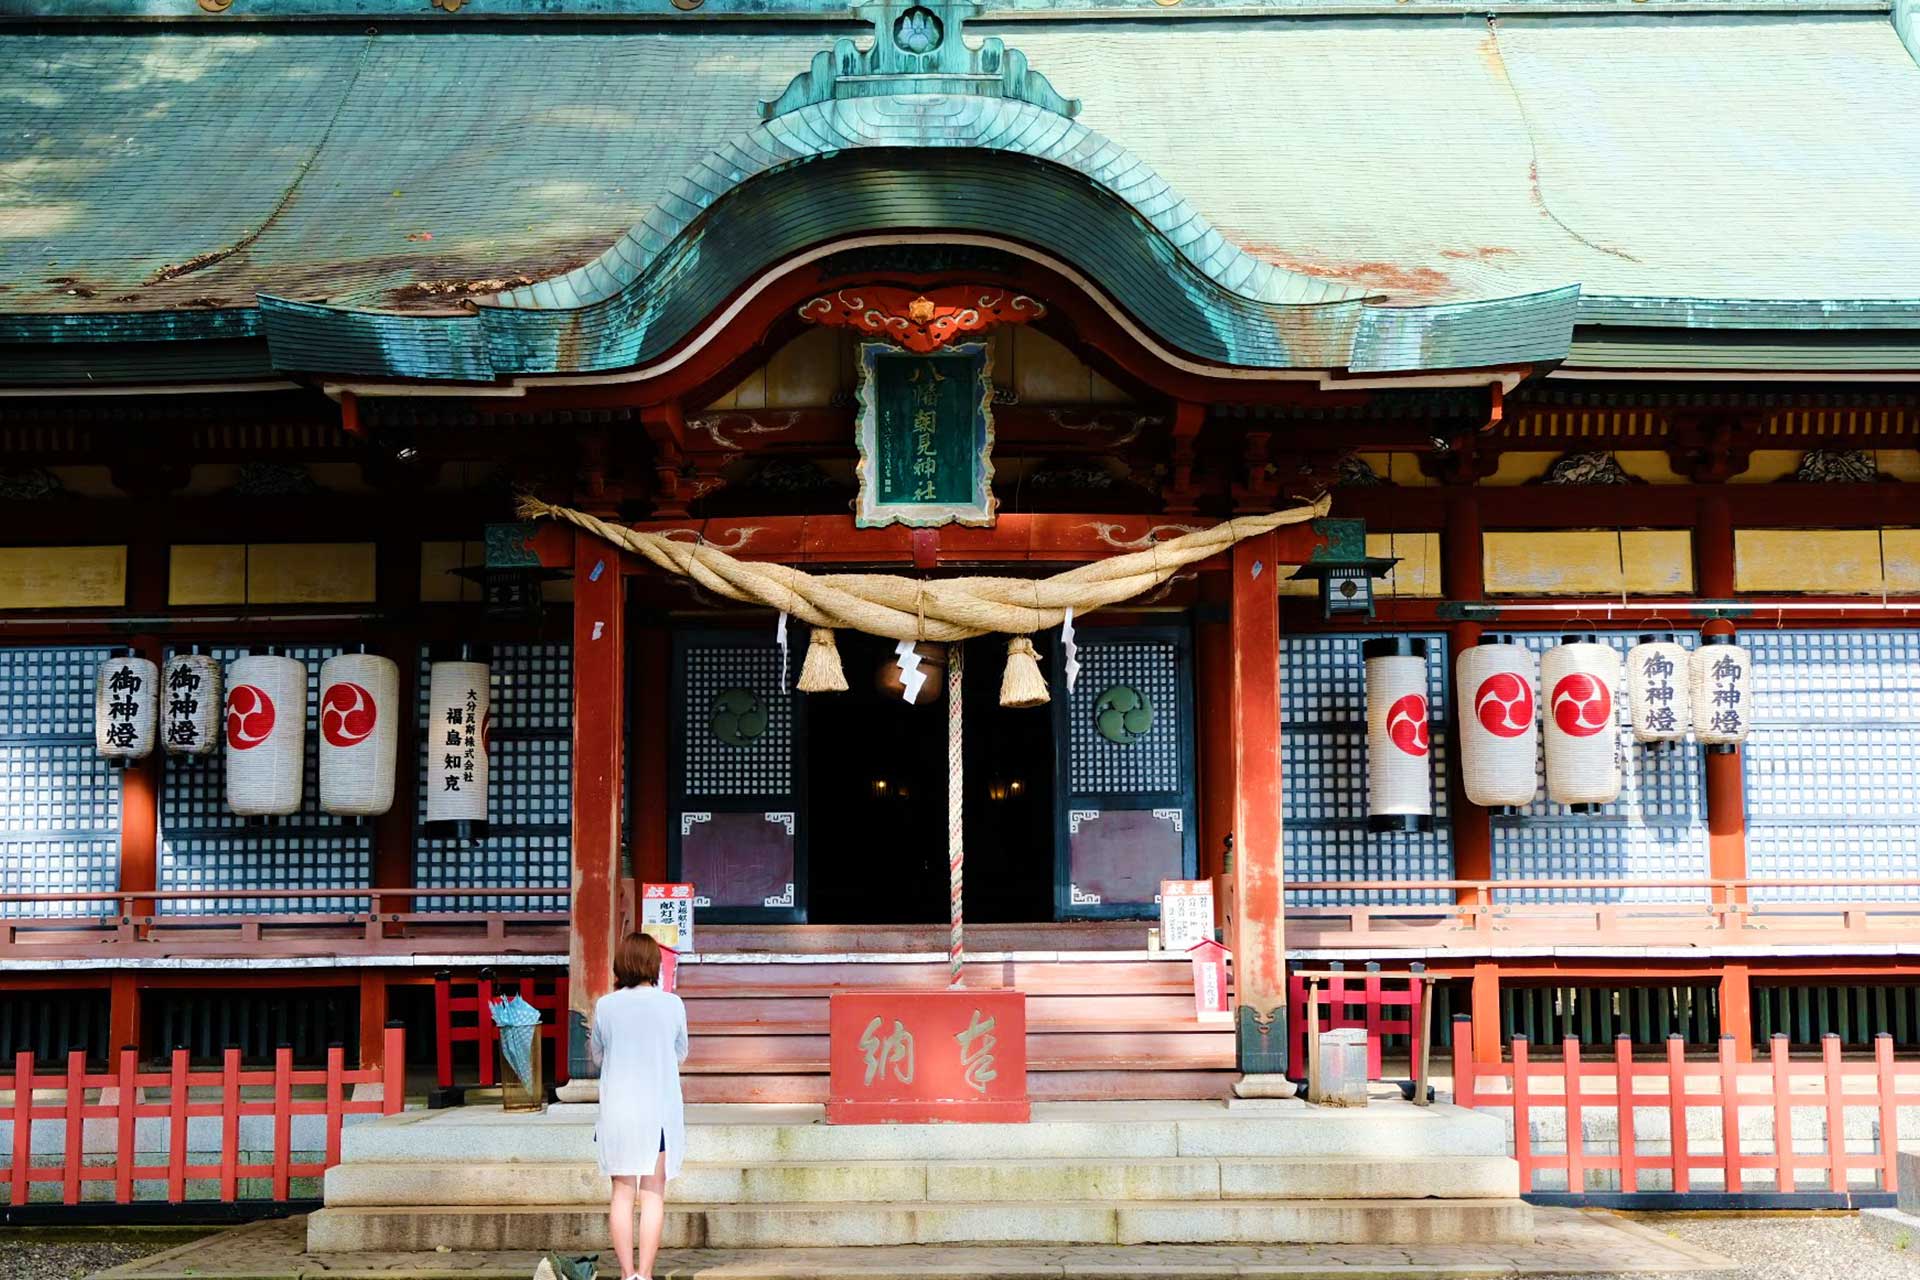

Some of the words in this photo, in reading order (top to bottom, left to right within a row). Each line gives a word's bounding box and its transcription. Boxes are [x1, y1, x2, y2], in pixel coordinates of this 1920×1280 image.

[107, 665, 142, 749] 御神燈
[168, 663, 201, 746] 御神燈
[1643, 651, 1676, 733] 御神燈
[1710, 654, 1742, 735] 御神燈
[444, 708, 463, 792] 福島知克
[463, 688, 478, 783] 大分瓦斯株式会社
